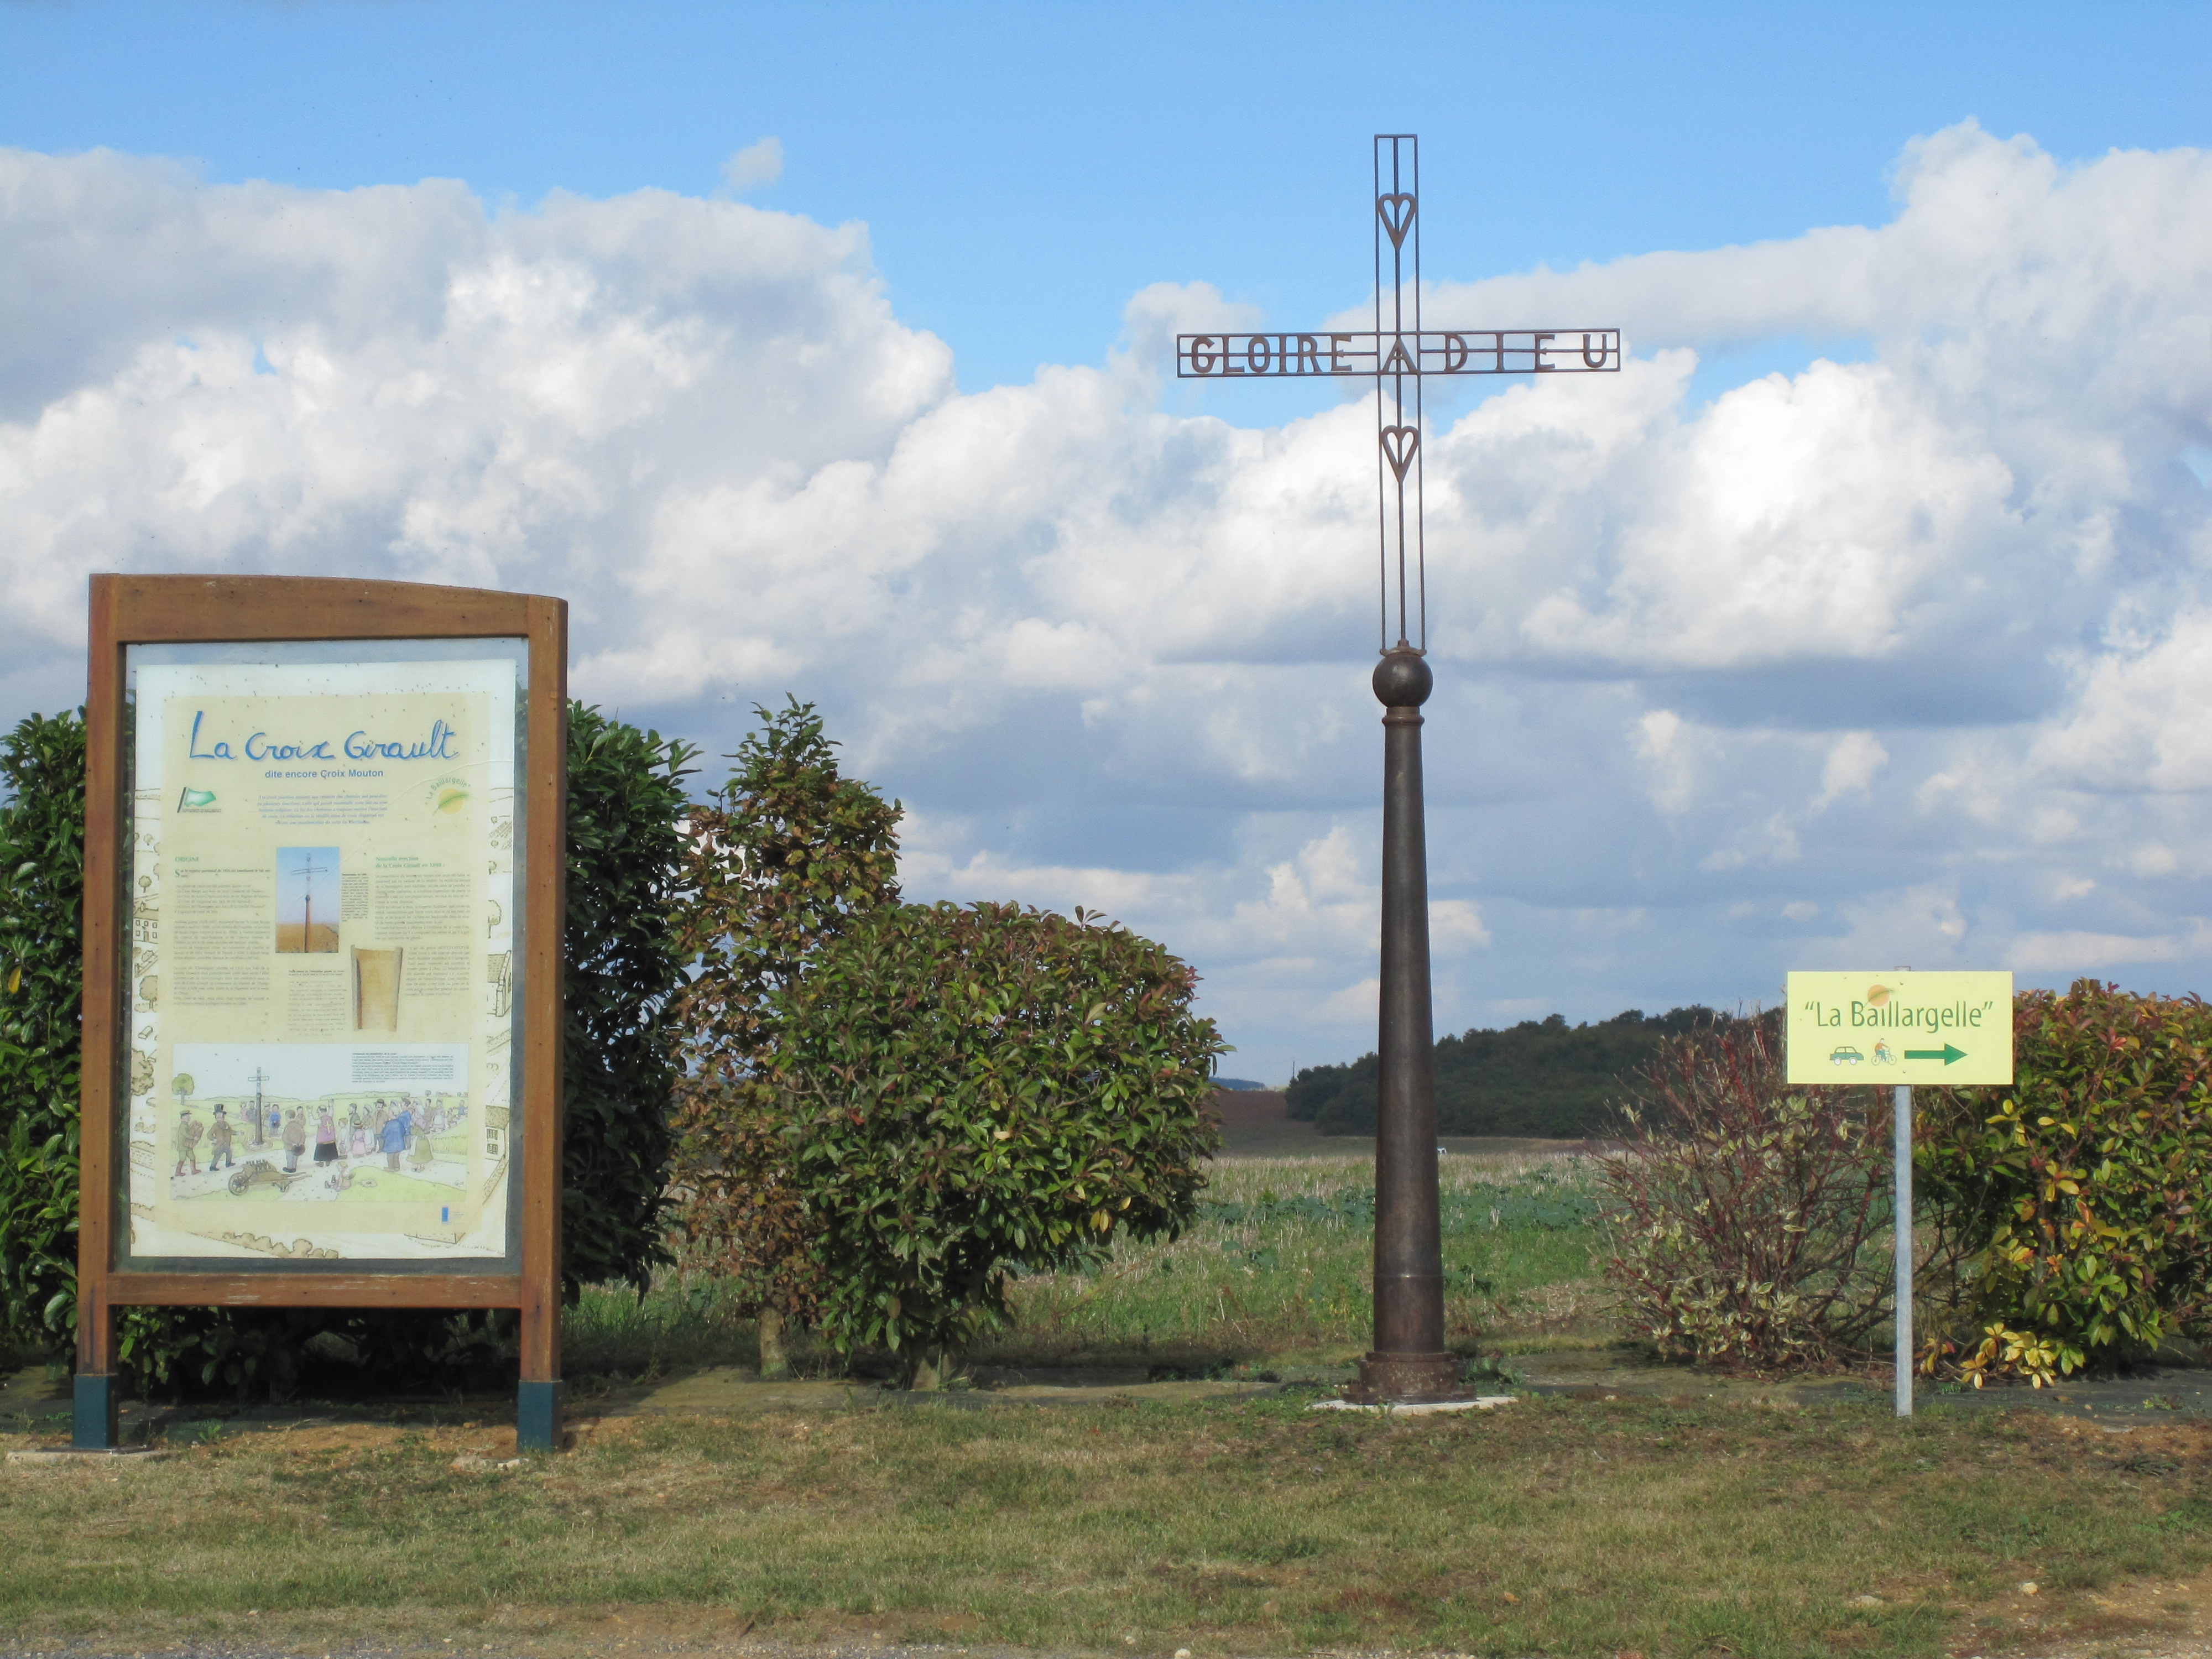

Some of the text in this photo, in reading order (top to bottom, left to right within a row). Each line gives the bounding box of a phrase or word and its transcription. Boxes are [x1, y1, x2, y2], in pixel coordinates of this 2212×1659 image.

[1191, 333, 1607, 373] GLOIRE A DIEU
[189, 711, 460, 761] La Croix Girault
[265, 769, 283, 778] dite
[320, 769, 345, 778] Croix
[348, 769, 384, 778] Mouton
